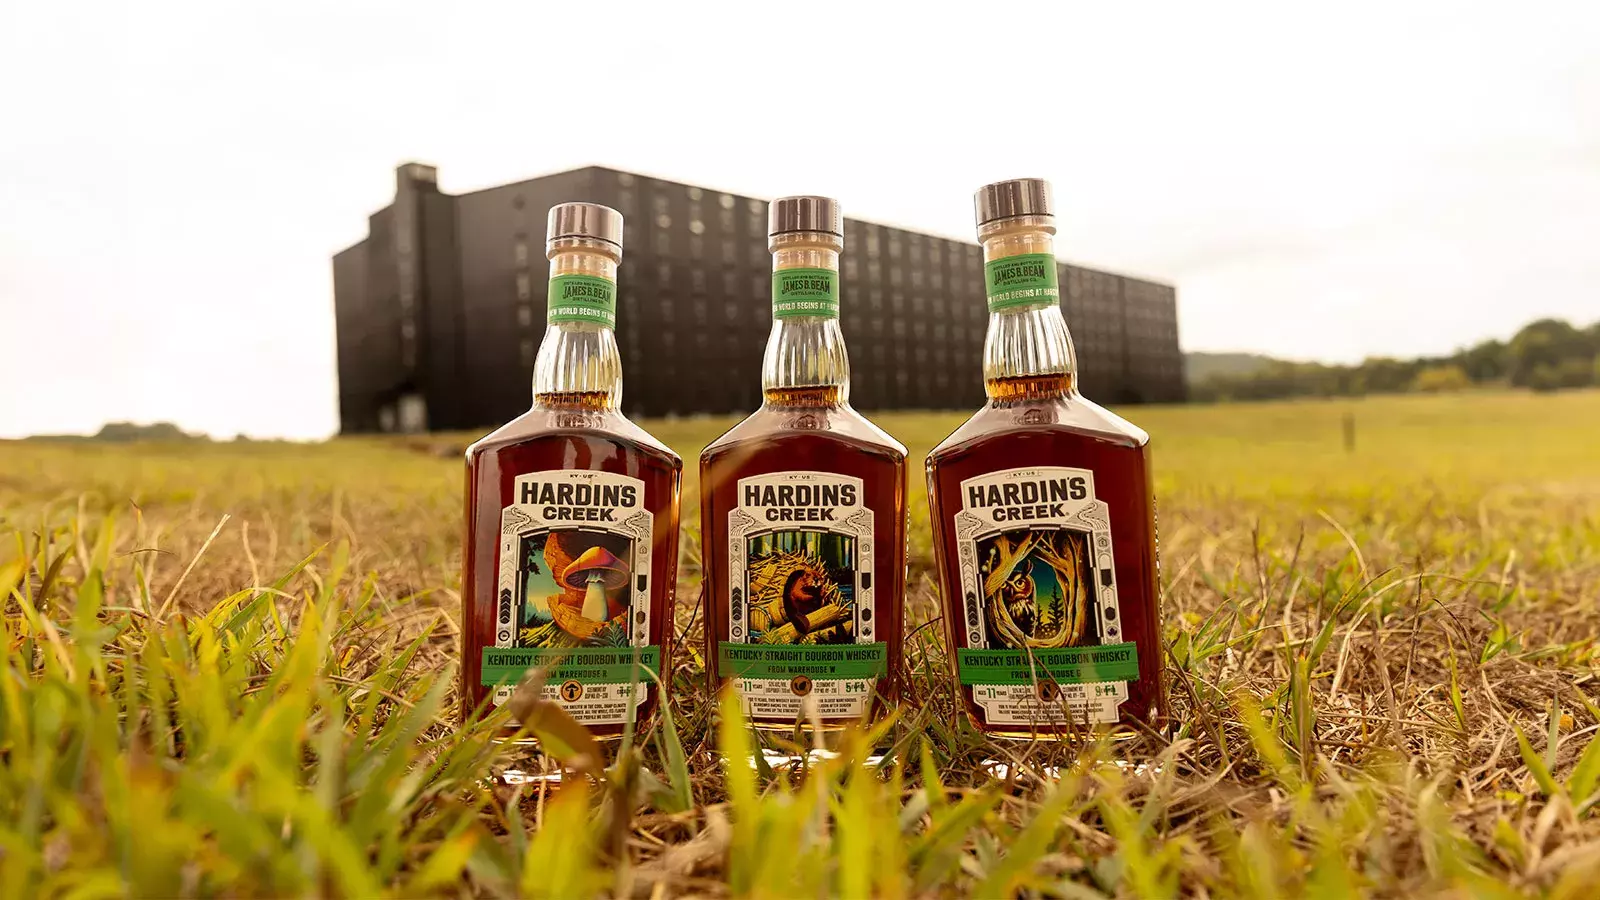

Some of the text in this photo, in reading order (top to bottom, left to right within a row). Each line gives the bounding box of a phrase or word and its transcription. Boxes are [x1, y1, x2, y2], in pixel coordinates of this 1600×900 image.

[994, 265, 1045, 286] JAMES B. BEAM
[782, 280, 830, 295] JAMES B. BEAM
[1011, 289, 1034, 299] BEGINS
[563, 286, 611, 304] JAMES B. BEAM
[579, 308, 600, 316] BEGINS
[797, 302, 818, 310] BEGINS
[521, 482, 636, 507] HARDIN'S
[745, 484, 856, 507] HARDIN'S
[968, 477, 1086, 508] HARDIN'S
[543, 506, 615, 521] CREEK
[766, 508, 835, 521] CREEK
[992, 503, 1065, 522] CREEK
[488, 654, 653, 666] KENTUCKY STRGHT BOURBON WHIKEY
[725, 649, 880, 661] KENTUCKY STRAIGHT BOURBON WHISKEY
[964, 650, 1130, 666] KENTUCKY STRAIHT BOURBON WHISKEY
[559, 670, 600, 678] WAREHOUSE
[744, 681, 752, 692] 11
[987, 688, 996, 698] 11
